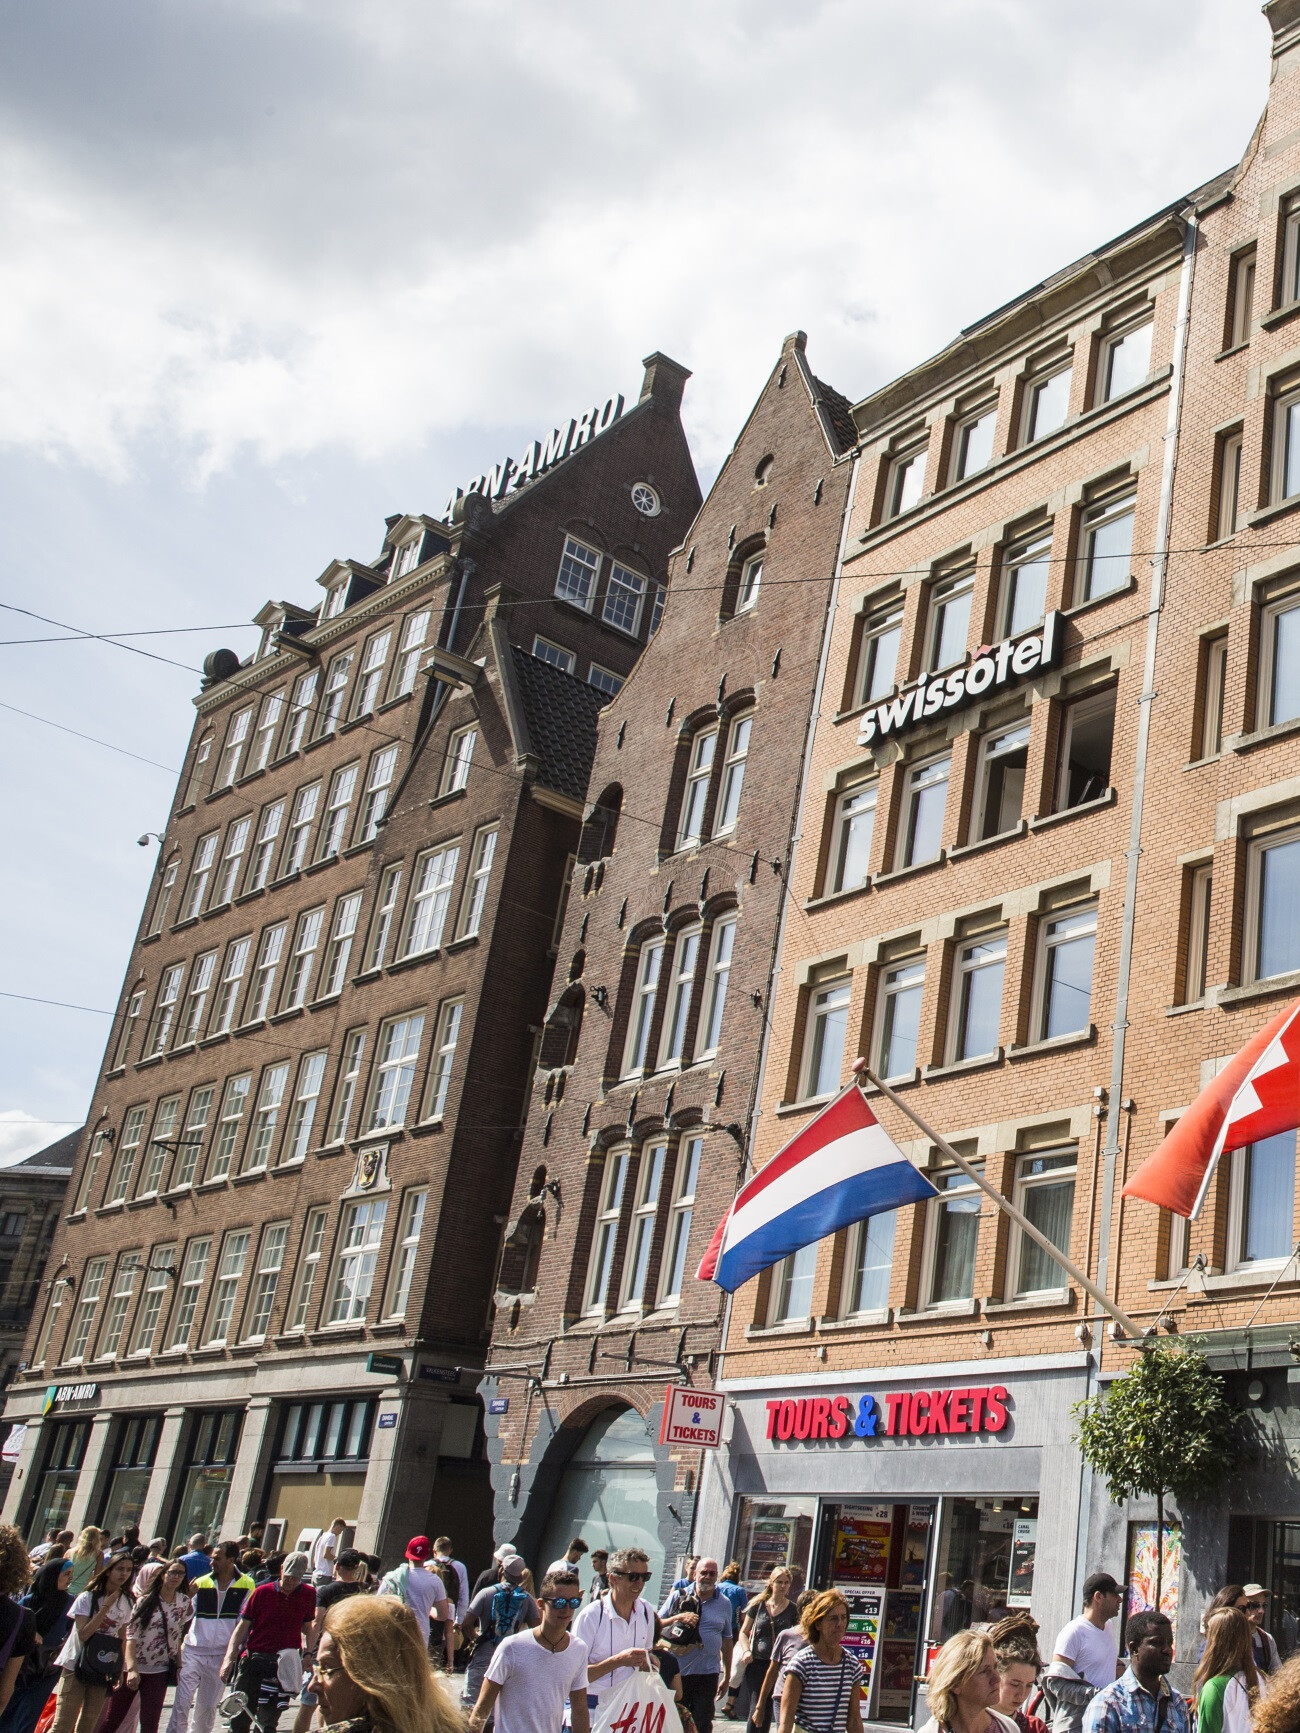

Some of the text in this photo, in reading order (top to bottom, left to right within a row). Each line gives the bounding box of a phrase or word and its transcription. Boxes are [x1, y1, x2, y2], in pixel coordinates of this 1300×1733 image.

[682, 1395, 717, 1410] TOURS
[692, 1412, 701, 1424] &
[766, 1385, 1008, 1441] TOURS & TICKETS
[673, 1426, 716, 1441] TICKETS
